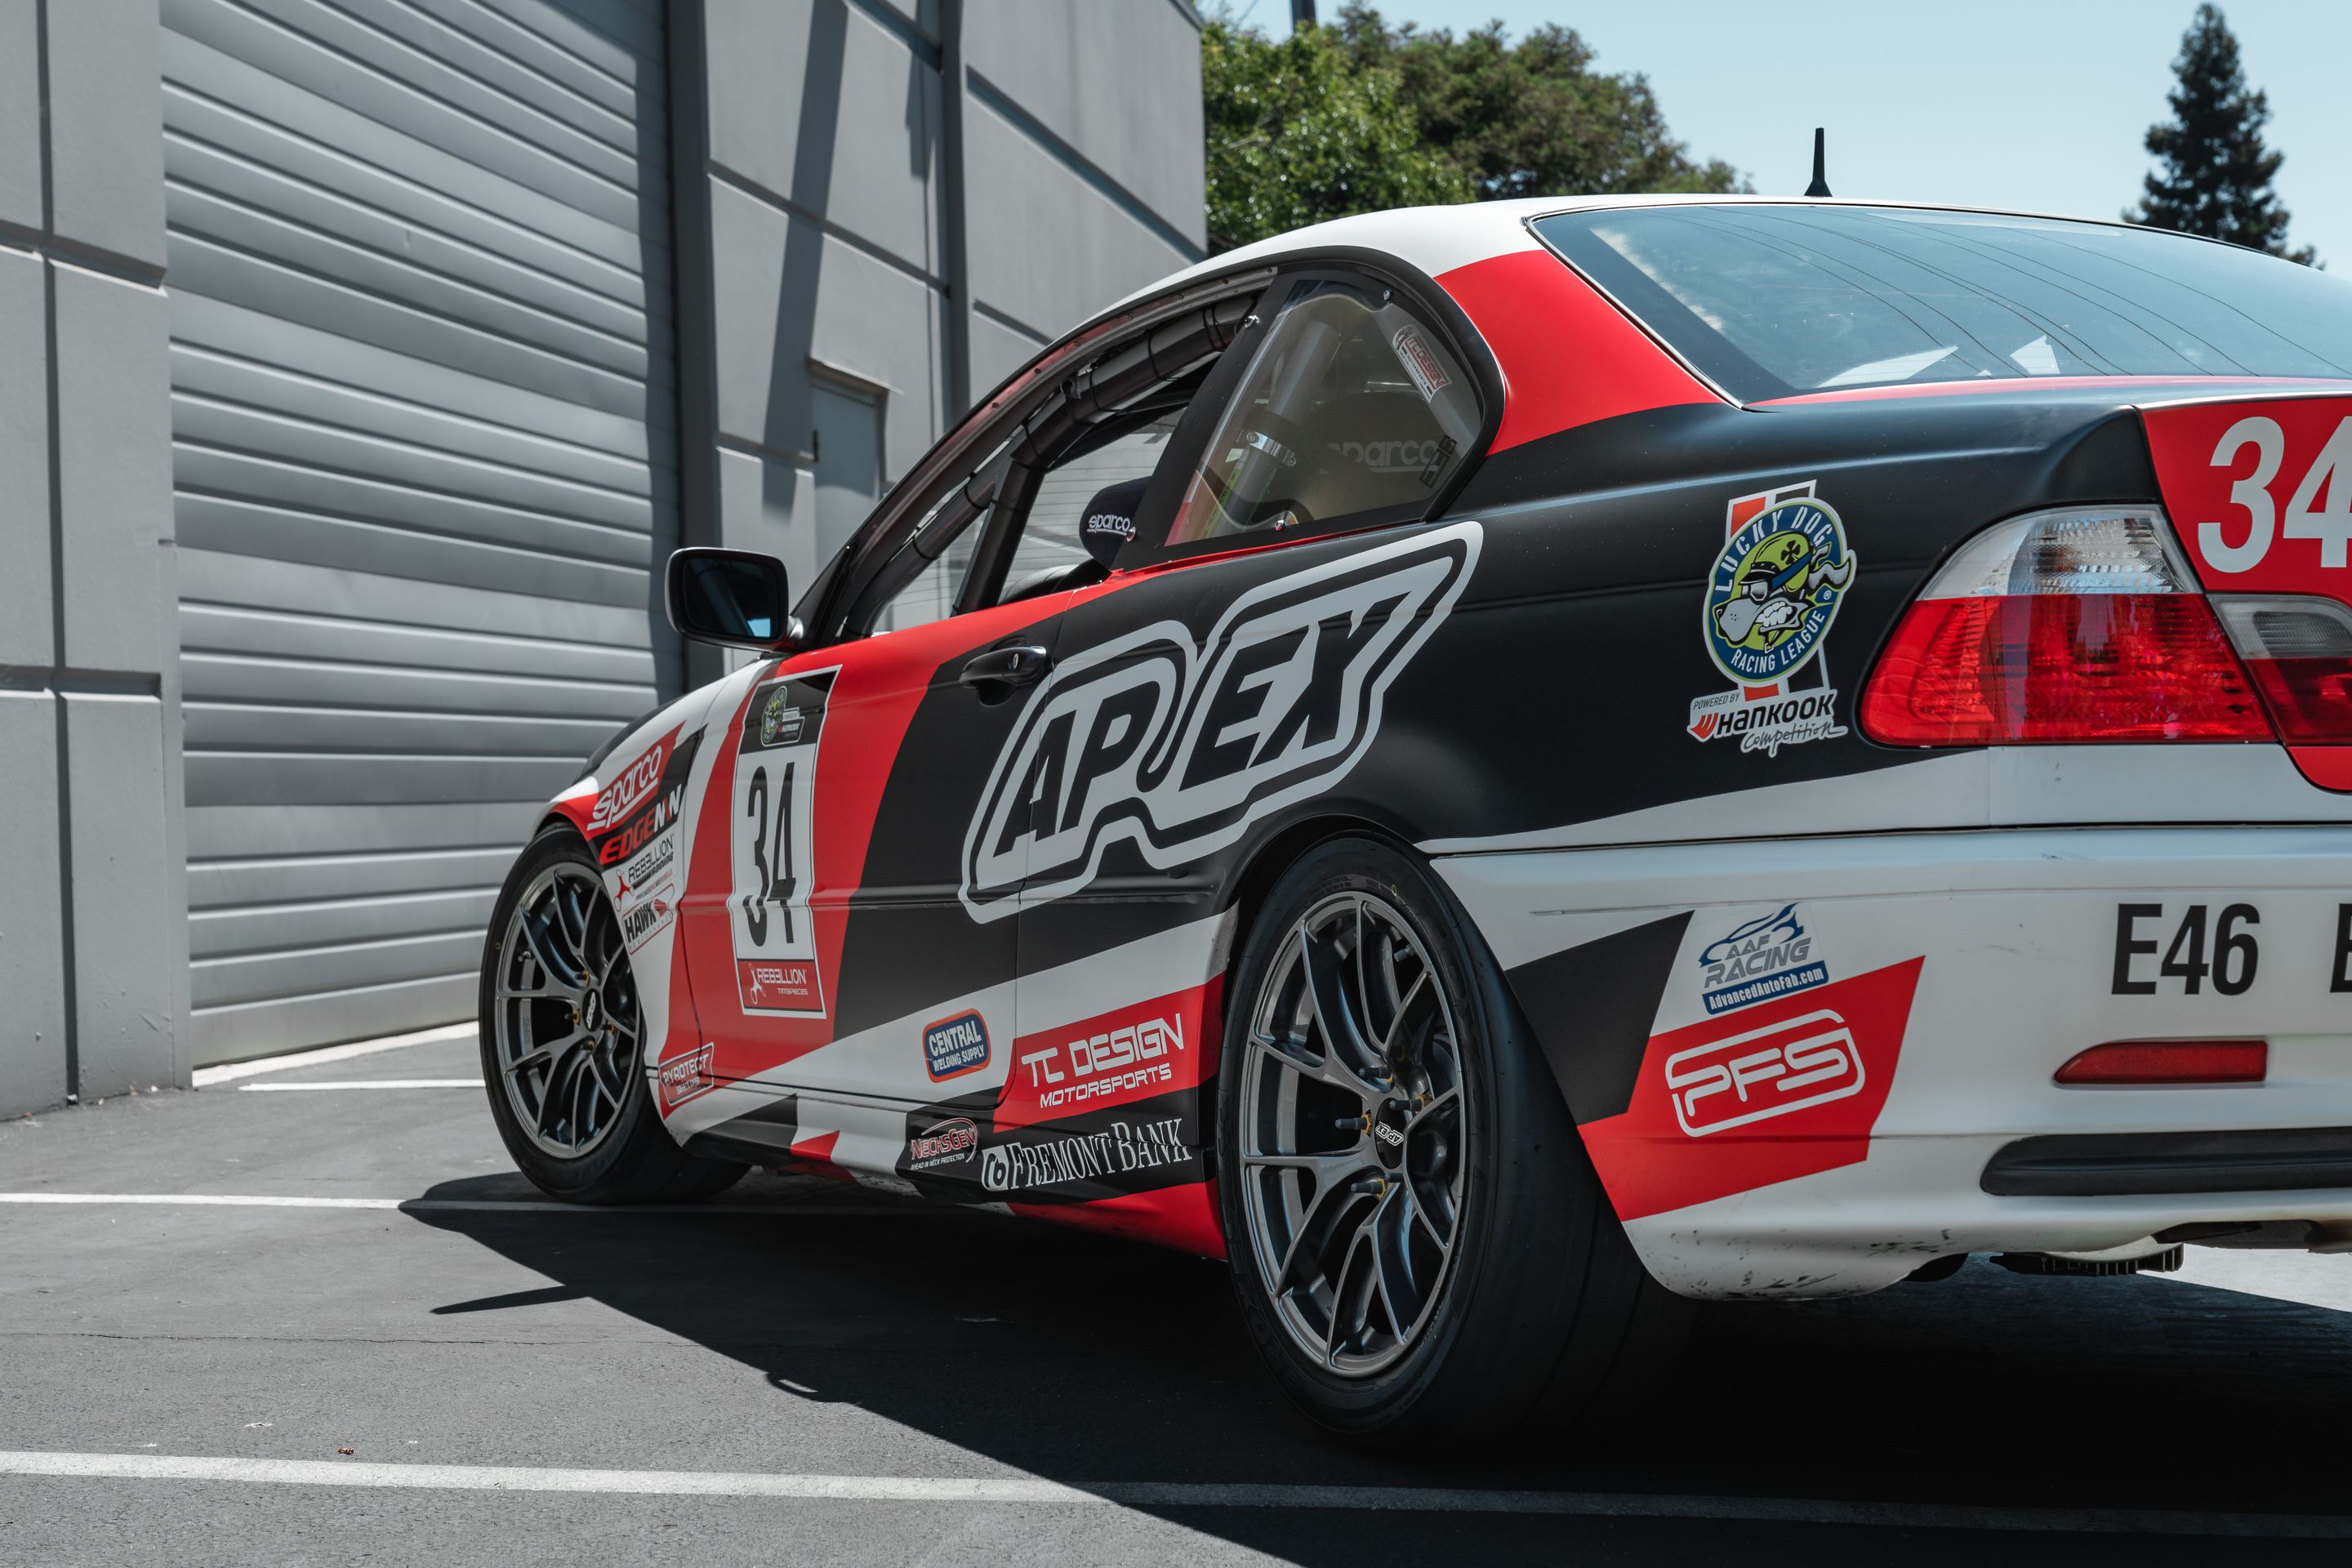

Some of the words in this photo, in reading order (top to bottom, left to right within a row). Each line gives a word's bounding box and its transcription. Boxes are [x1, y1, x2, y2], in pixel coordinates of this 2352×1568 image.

[2198, 416, 2352, 572] 34
[1089, 514, 1130, 533] sparco
[1715, 509, 1784, 592] LUCKY
[1791, 506, 1833, 547] DOG
[1731, 648, 1775, 674] RACING
[1780, 610, 1825, 666] LEAGUE
[984, 576, 1429, 866] APEX
[1693, 696, 1729, 710] POWERED
[1730, 693, 1742, 702] BY
[1744, 721, 1845, 755] Competition
[592, 745, 662, 829] sparco
[628, 834, 674, 884] REBELLION
[743, 761, 797, 948] 34
[624, 899, 657, 943] HAWK
[1704, 938, 1811, 988] RACING
[1725, 934, 1771, 960] AAF
[2111, 903, 2261, 996] E46
[756, 968, 807, 984] REBELLION
[1709, 968, 1824, 1009] AdvancedAutoFab.com
[929, 1020, 982, 1057] CENTRAL
[933, 1053, 961, 1071] WELDING
[961, 1045, 984, 1062] SUPPLY
[1021, 1048, 1064, 1087] TC
[1068, 1013, 1185, 1077] DESIGN
[662, 1054, 710, 1085] PYROTECT
[1040, 1062, 1172, 1108] MOTORSPORTS
[1668, 1027, 1849, 1117] PFS
[911, 1161, 924, 1171] AHEAD
[941, 1152, 965, 1164] PROTECTION
[1006, 1132, 1116, 1190] FREMONT
[1111, 1118, 1192, 1172] BANK
